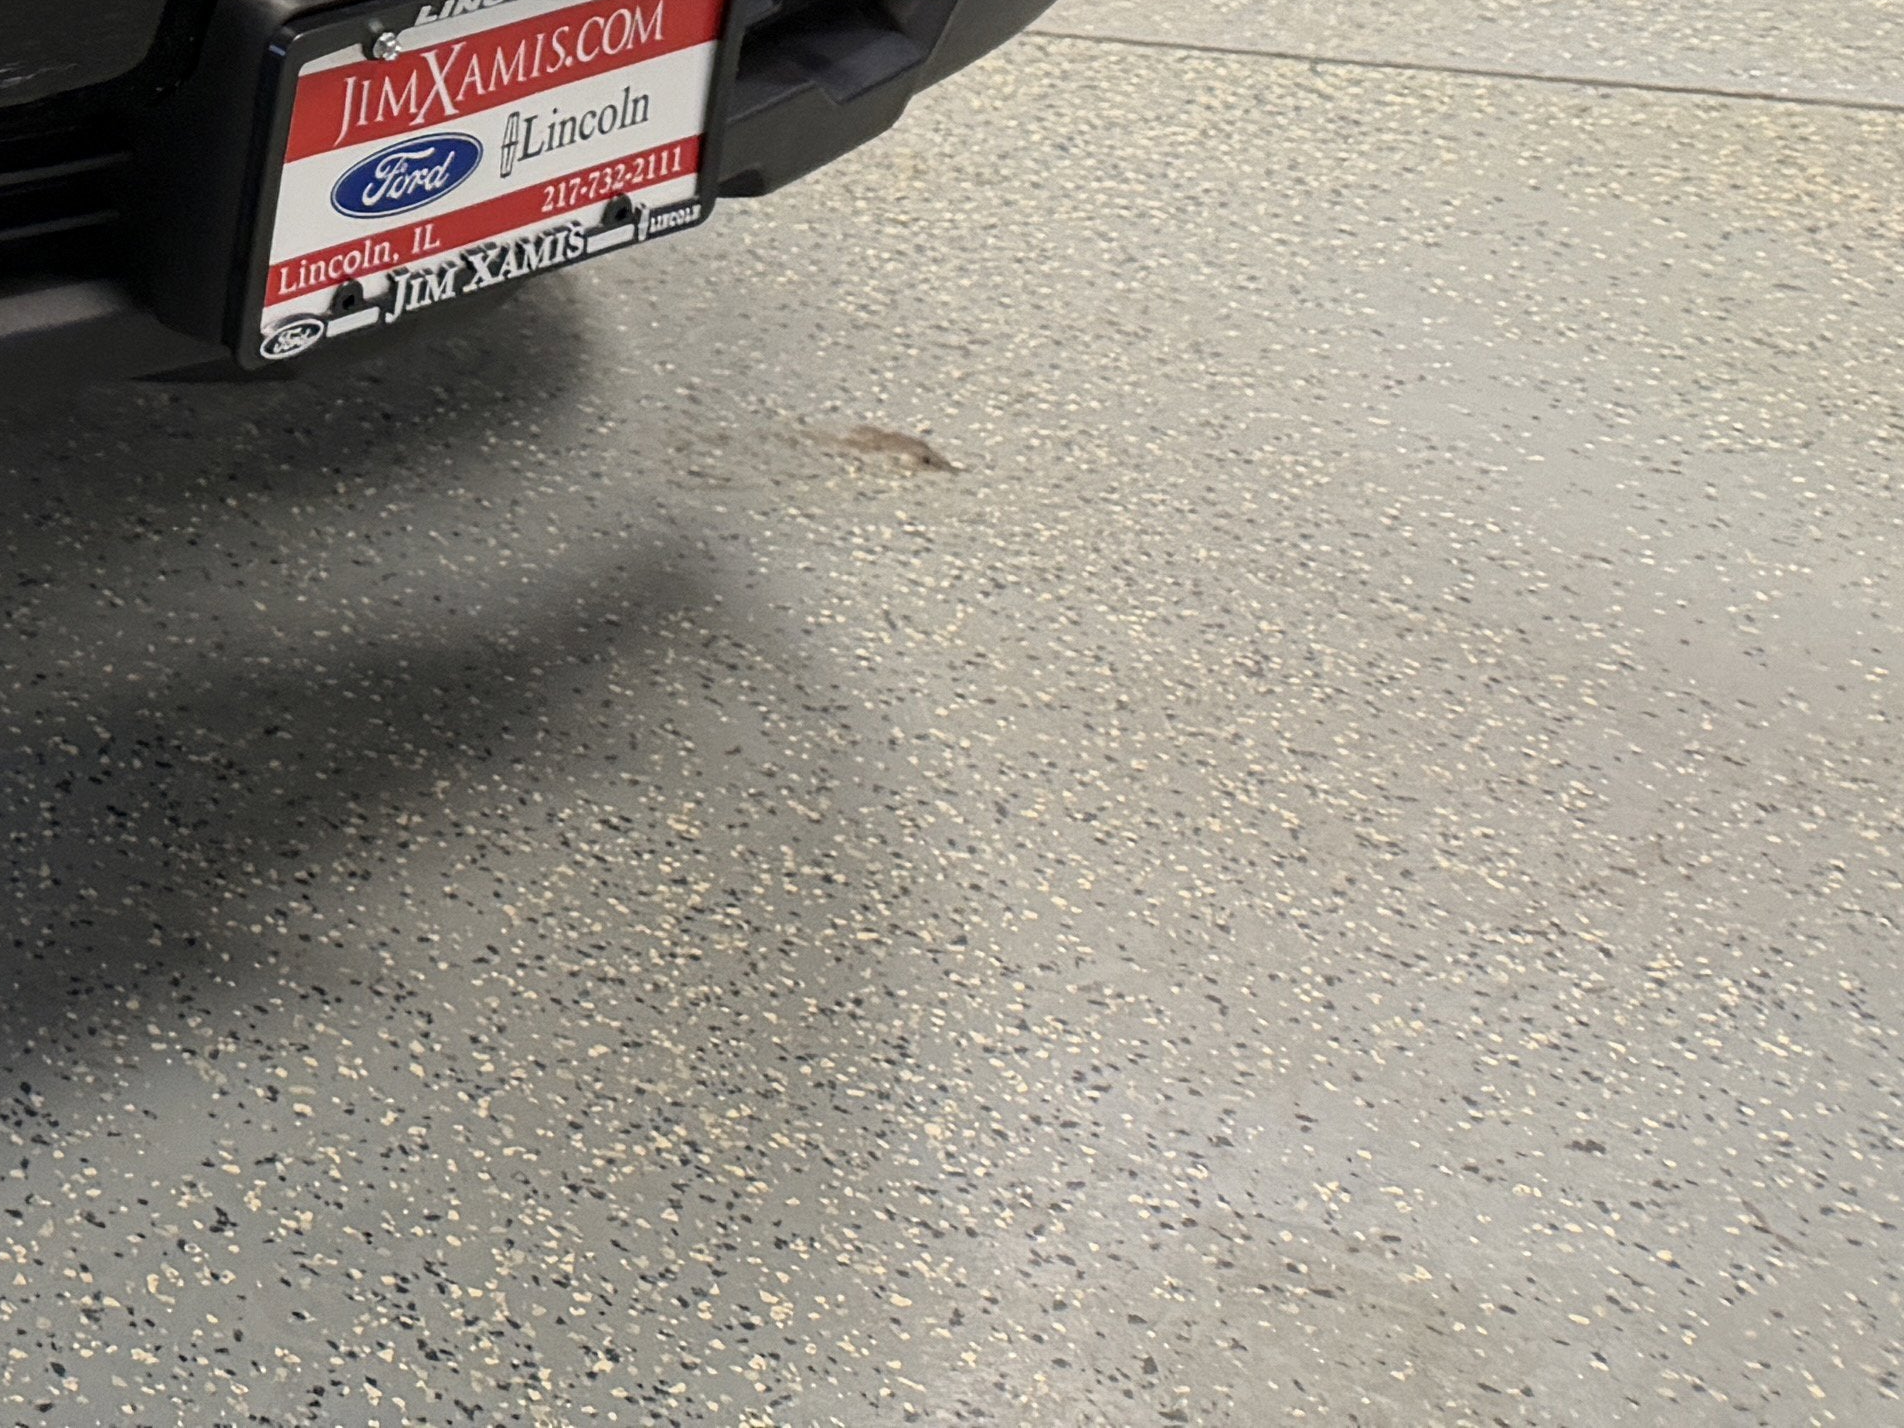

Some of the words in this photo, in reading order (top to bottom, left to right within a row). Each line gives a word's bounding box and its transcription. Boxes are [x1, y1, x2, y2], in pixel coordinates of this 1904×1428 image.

[517, 85, 650, 162] Lincoln
[361, 147, 456, 207] Ford
[541, 145, 683, 213] 217-732-2111
[278, 239, 400, 296] Lincoln,
[411, 223, 441, 255] IL
[384, 267, 460, 324] JIM
[462, 227, 586, 293] XAMIS
